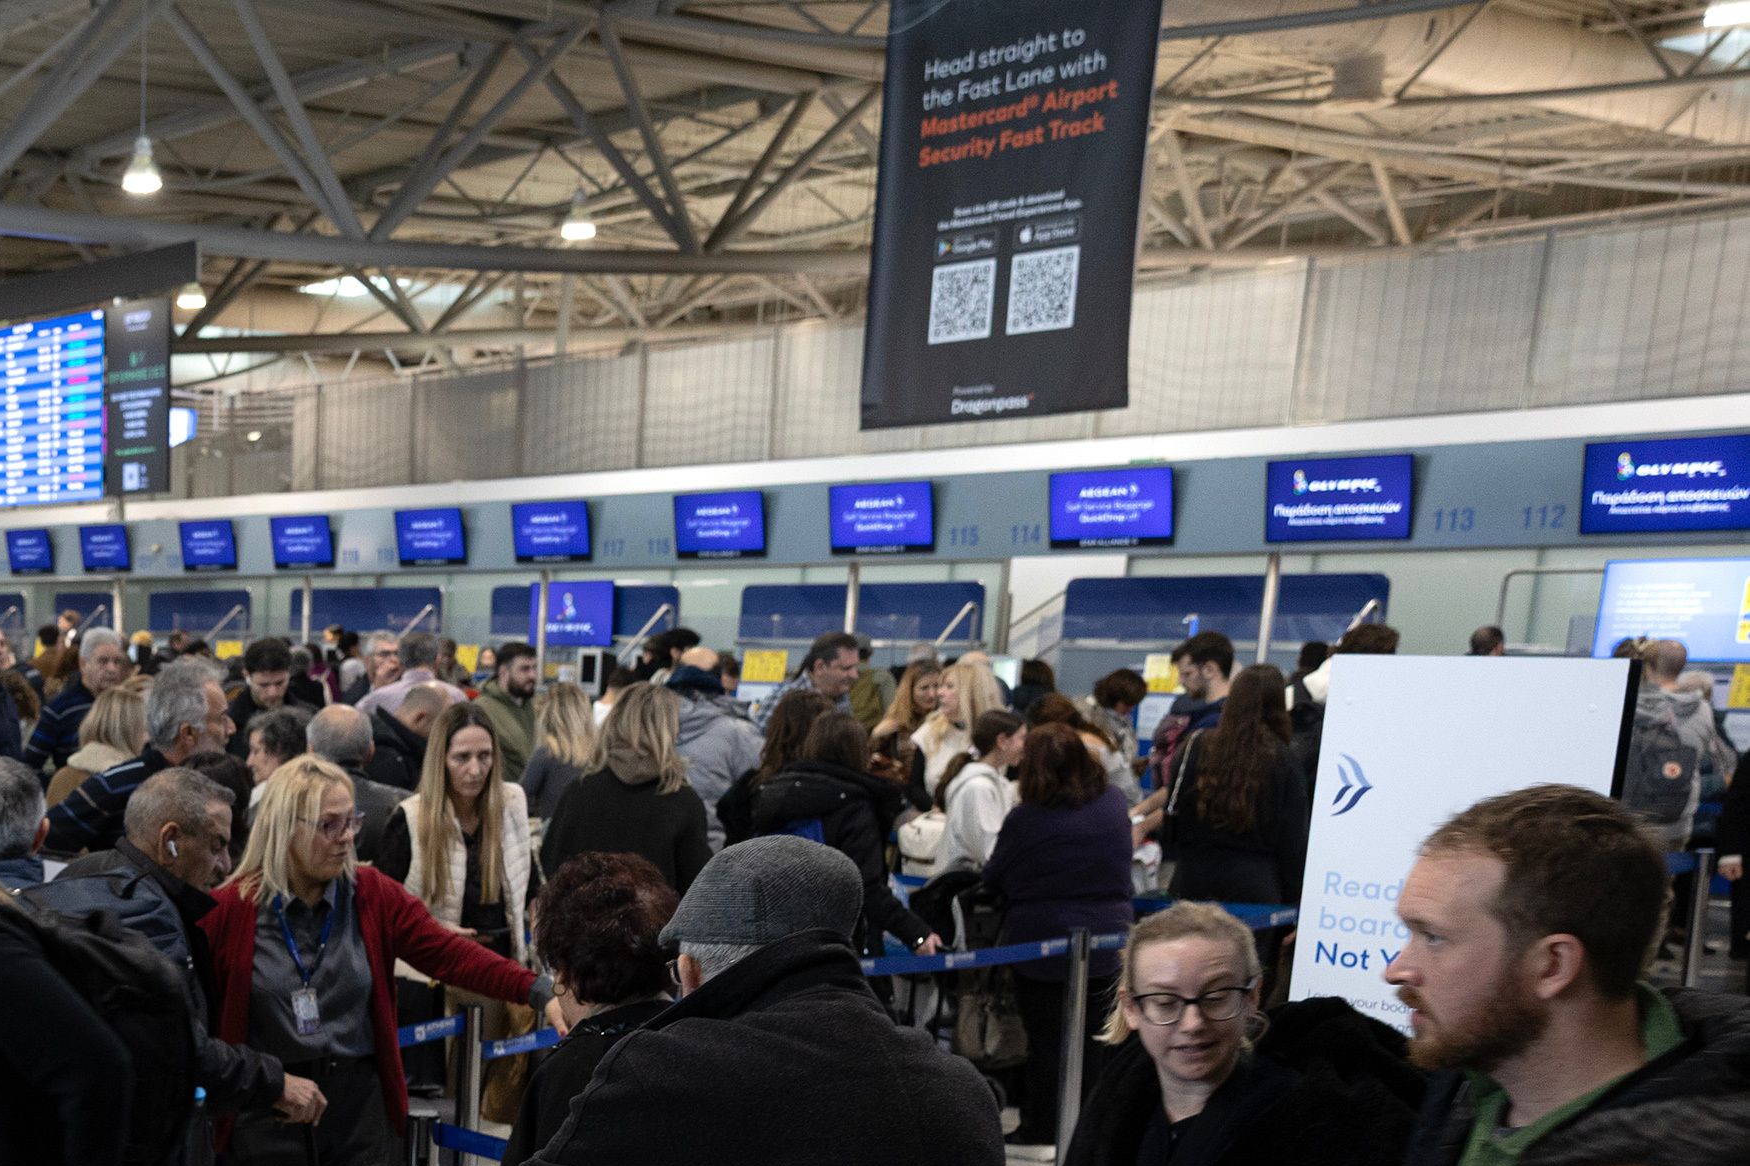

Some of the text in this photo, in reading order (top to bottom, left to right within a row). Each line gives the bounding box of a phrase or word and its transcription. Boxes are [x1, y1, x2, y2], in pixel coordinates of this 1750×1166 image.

[924, 28, 1086, 81] Head straight to
[923, 49, 1107, 111] the Fast Lane with
[1042, 79, 1119, 112] Airport
[919, 111, 1106, 168] Security Fast Track
[1079, 486, 1128, 498] AEGEAN
[1433, 507, 1475, 532] 113
[1523, 504, 1567, 529] 112
[1010, 523, 1041, 545] 114
[1315, 940, 1370, 971] Not
